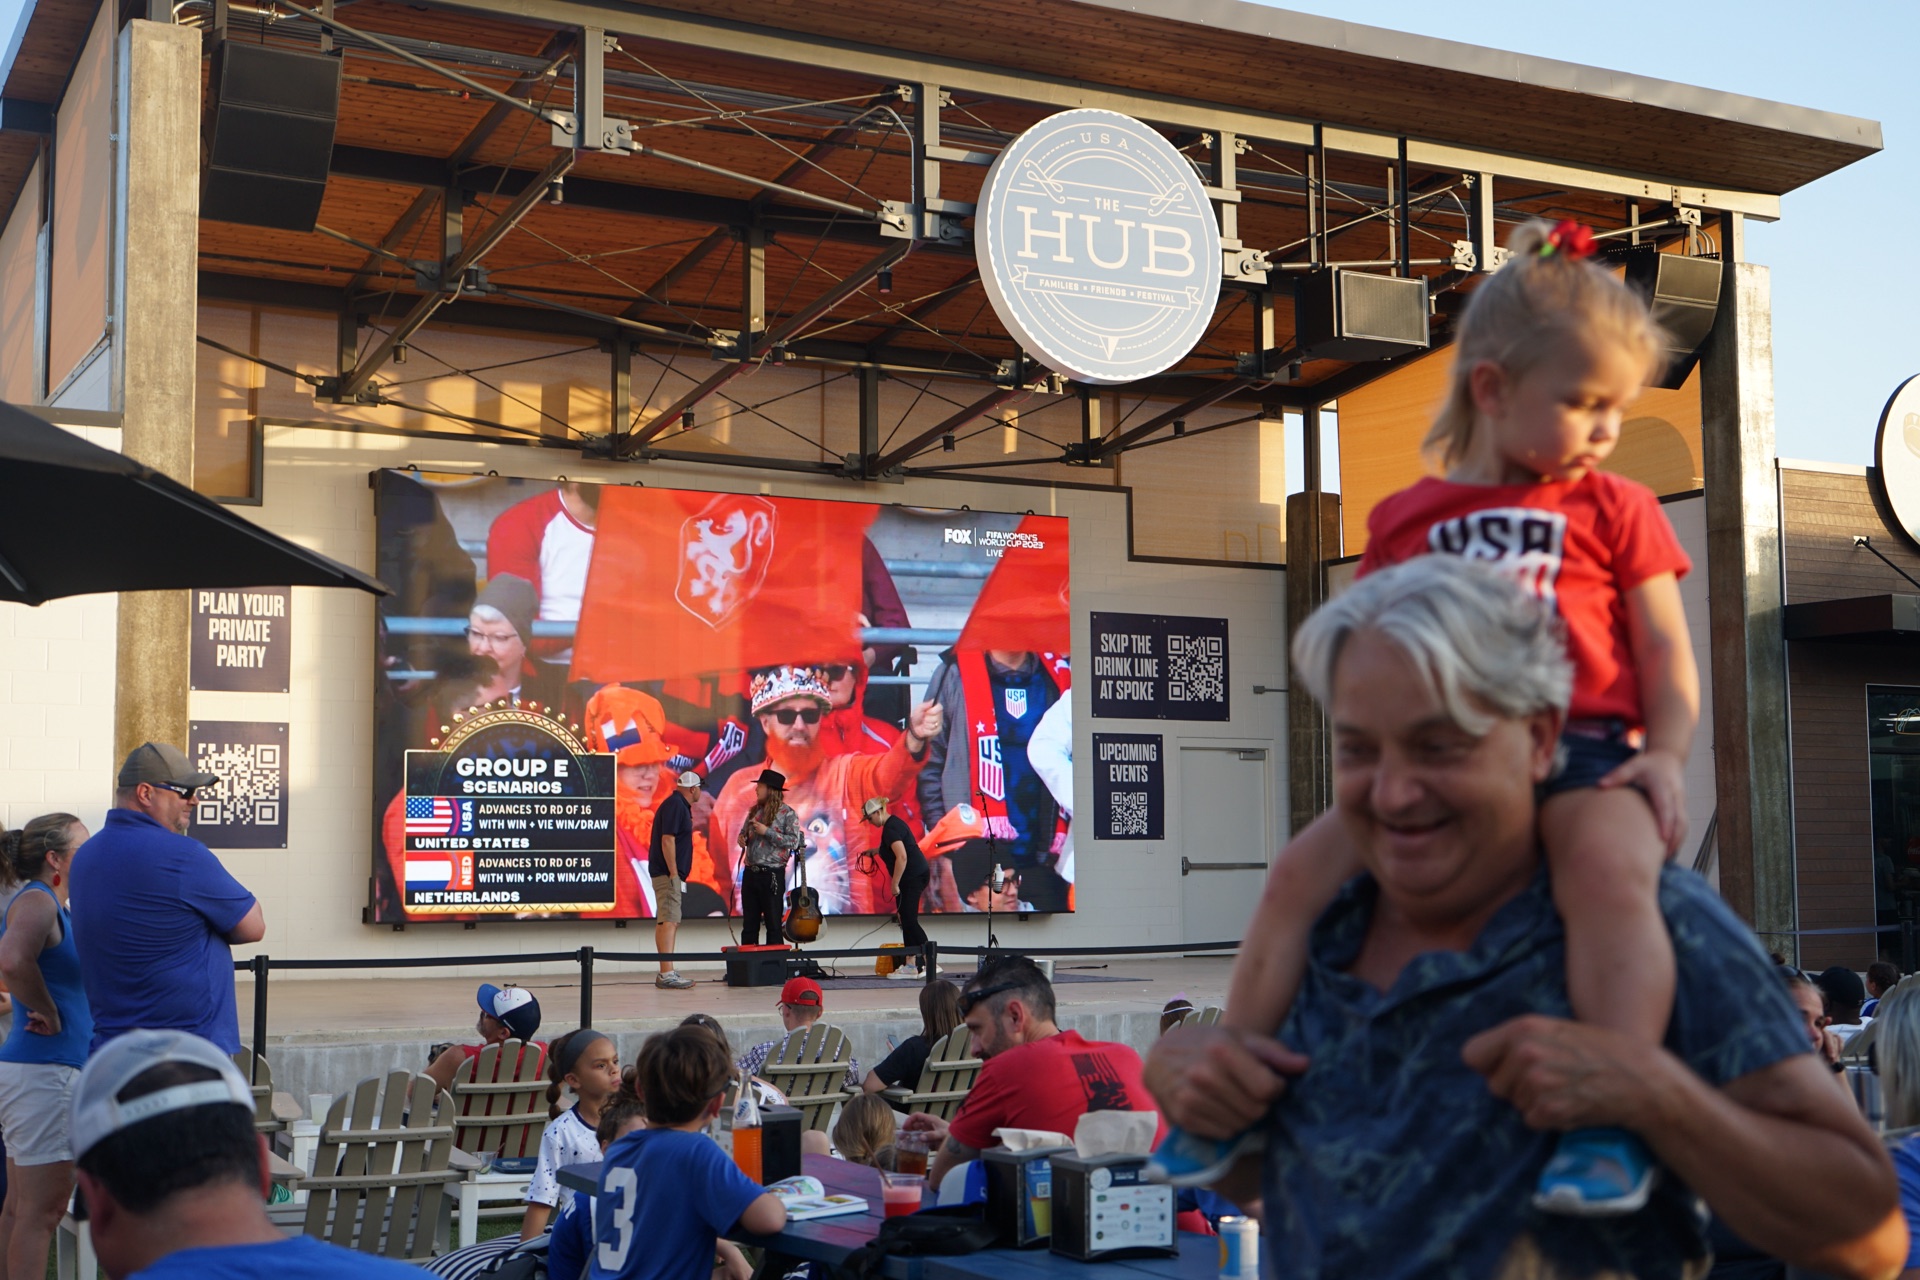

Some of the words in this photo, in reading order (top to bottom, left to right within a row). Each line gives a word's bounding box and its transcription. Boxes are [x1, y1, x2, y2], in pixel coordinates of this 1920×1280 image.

[1080, 131, 1131, 151] USA
[1094, 197, 1120, 212] THE
[1016, 205, 1196, 278] HUB
[1039, 278, 1079, 291] FAMILIES
[1090, 284, 1126, 297] FRIENDS
[1136, 290, 1176, 303] FESTIVAL
[944, 528, 972, 545] FOX
[978, 537, 1005, 547] WORLD
[1006, 539, 1022, 548] CUP
[986, 531, 1002, 539] FIFA
[1002, 532, 1038, 542] WOMEN'S
[1436, 515, 1555, 561] USA
[986, 549, 1003, 558] LIVE
[199, 591, 239, 615] PLAN
[242, 593, 285, 617] YOUR
[208, 618, 271, 642] PRIVATE
[1100, 633, 1129, 654] SKIP
[1131, 634, 1152, 655] THE
[216, 644, 266, 668] PARTY
[1094, 657, 1132, 678] DRINK
[1134, 658, 1159, 678] LINE
[1007, 689, 1025, 702] USA
[1099, 680, 1115, 700] AT
[1116, 680, 1154, 701] SPOKE
[981, 738, 1002, 765] US
[1099, 743, 1157, 762] UPCOMING
[456, 758, 547, 777] GROUP
[554, 760, 568, 778] E
[1109, 764, 1149, 783] EVENTS
[462, 780, 562, 794] SCENARIOS
[462, 801, 473, 831] USA
[479, 805, 532, 815] ADVANCES
[534, 805, 547, 815] TO
[550, 805, 562, 815] RD
[566, 805, 578, 815] OF
[581, 805, 592, 815] 16
[479, 819, 504, 830] WITH
[506, 819, 526, 830] WIN
[538, 819, 553, 830] VIE
[556, 819, 609, 830] WIN/DRAW
[415, 838, 469, 848] UNITED
[473, 838, 530, 848] STATES
[462, 856, 472, 885] NED
[479, 858, 530, 868] ADVANCES
[533, 858, 546, 868] TO
[550, 858, 562, 868] RD
[566, 858, 578, 868] OF
[581, 858, 591, 868] 16
[478, 873, 504, 883] WITH
[506, 873, 526, 883] WIN
[536, 873, 554, 883] POR
[557, 873, 608, 883] WIN/DRAW
[414, 892, 520, 903] NETHERLANDS
[598, 1166, 638, 1271] 3
